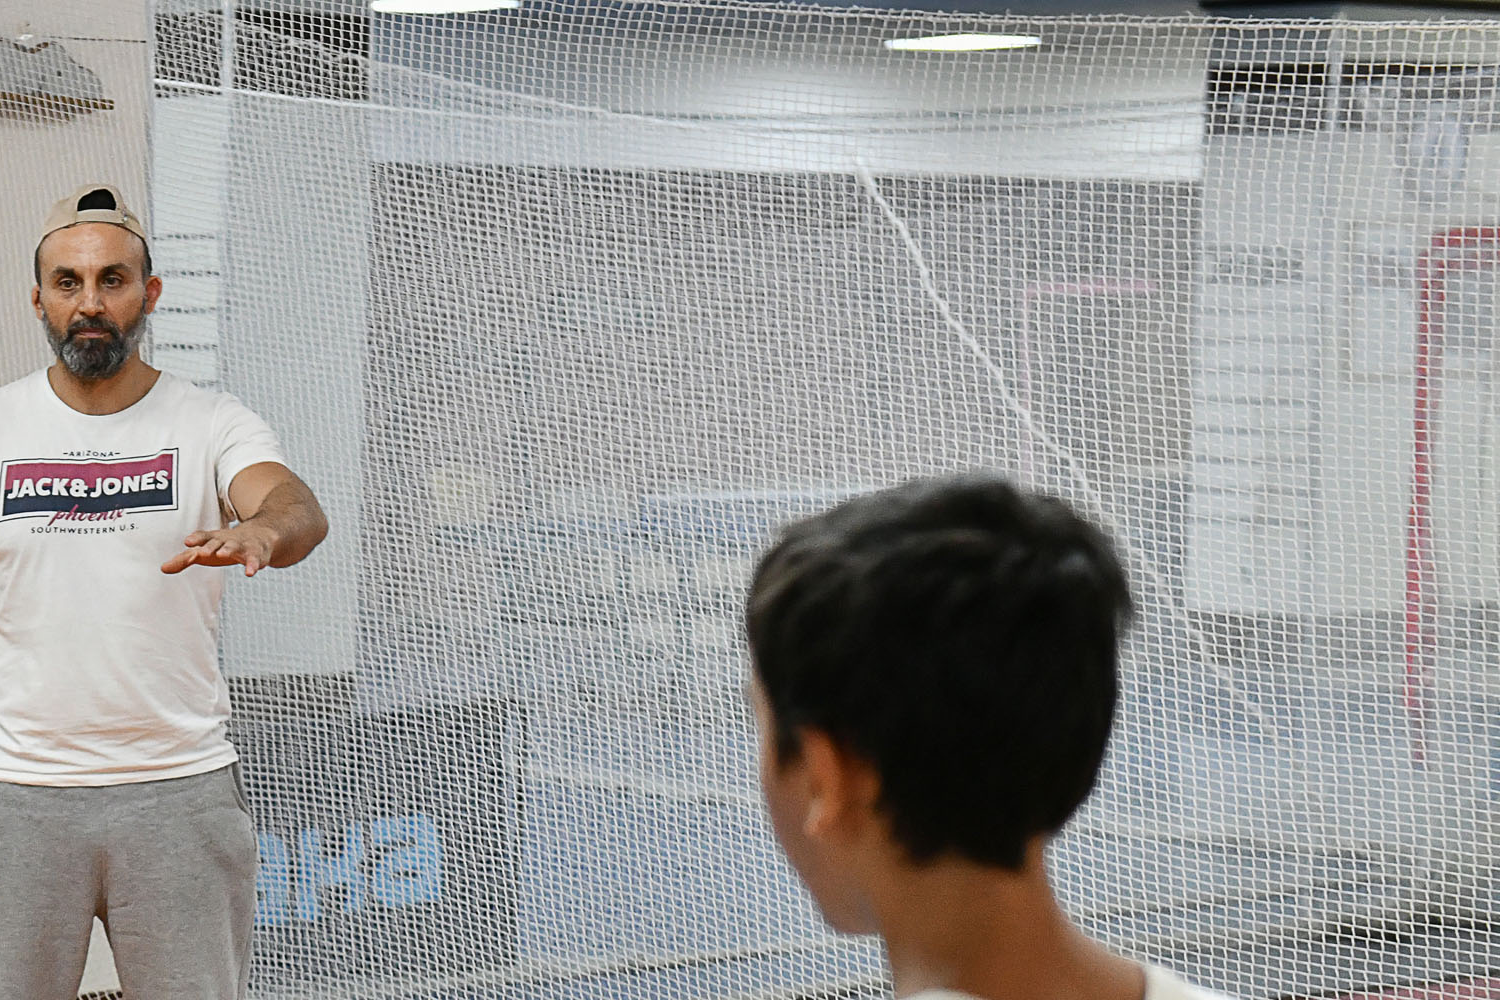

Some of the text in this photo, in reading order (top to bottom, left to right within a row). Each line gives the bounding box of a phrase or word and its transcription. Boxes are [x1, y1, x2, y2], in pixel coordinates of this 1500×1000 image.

[47, 504, 125, 527] phoenix
[30, 523, 139, 535] SOUTHWESTERN U.S.
